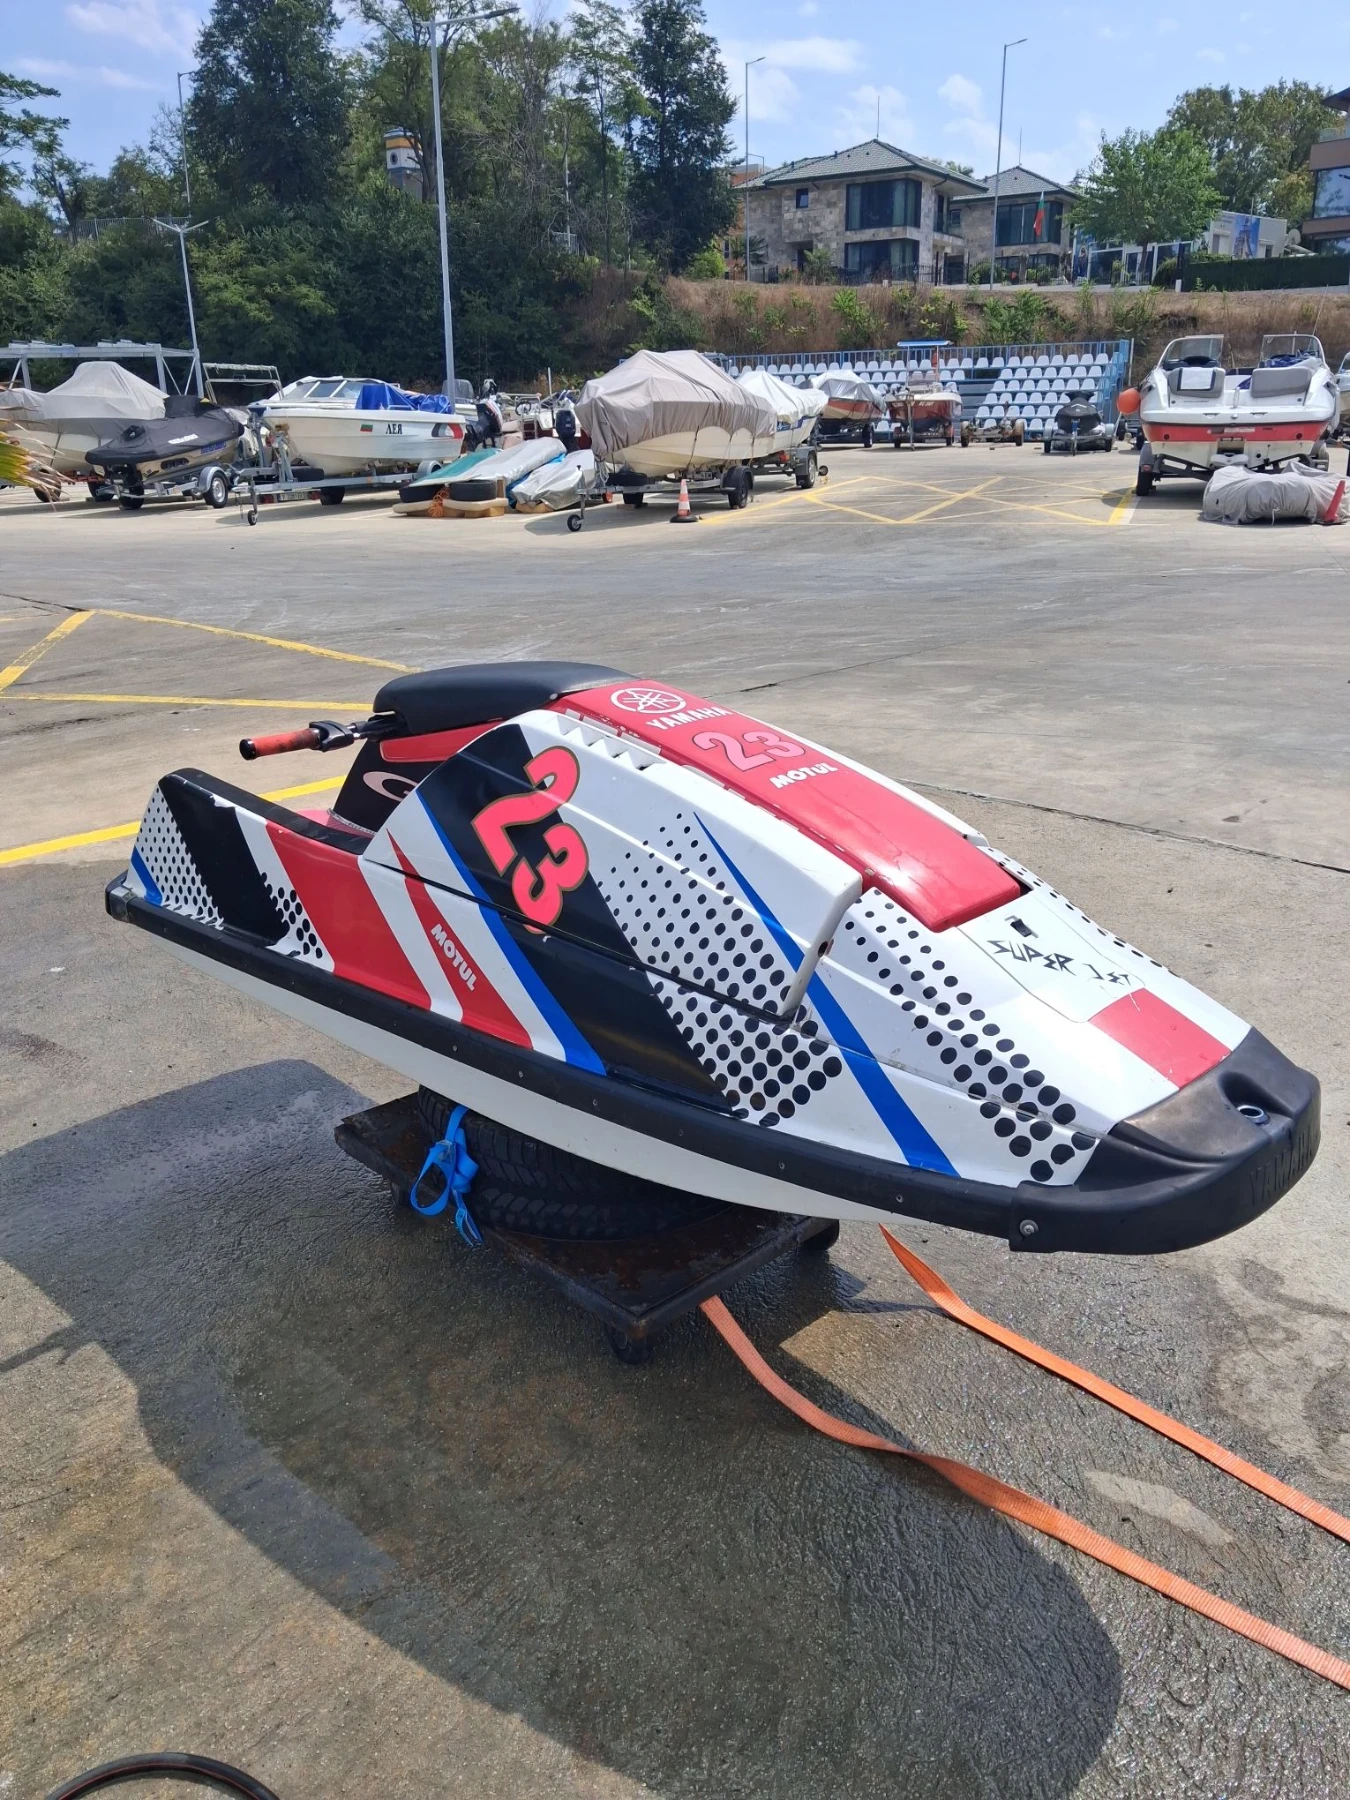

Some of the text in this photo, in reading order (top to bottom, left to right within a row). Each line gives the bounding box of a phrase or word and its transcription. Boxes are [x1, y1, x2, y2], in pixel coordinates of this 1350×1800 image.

[645, 706, 733, 730] YAMAHA
[691, 731, 805, 772] 23
[769, 762, 839, 789] MOTUL
[471, 746, 589, 934] 23
[430, 924, 477, 992] MOTUL
[986, 939, 1077, 976] SUPER
